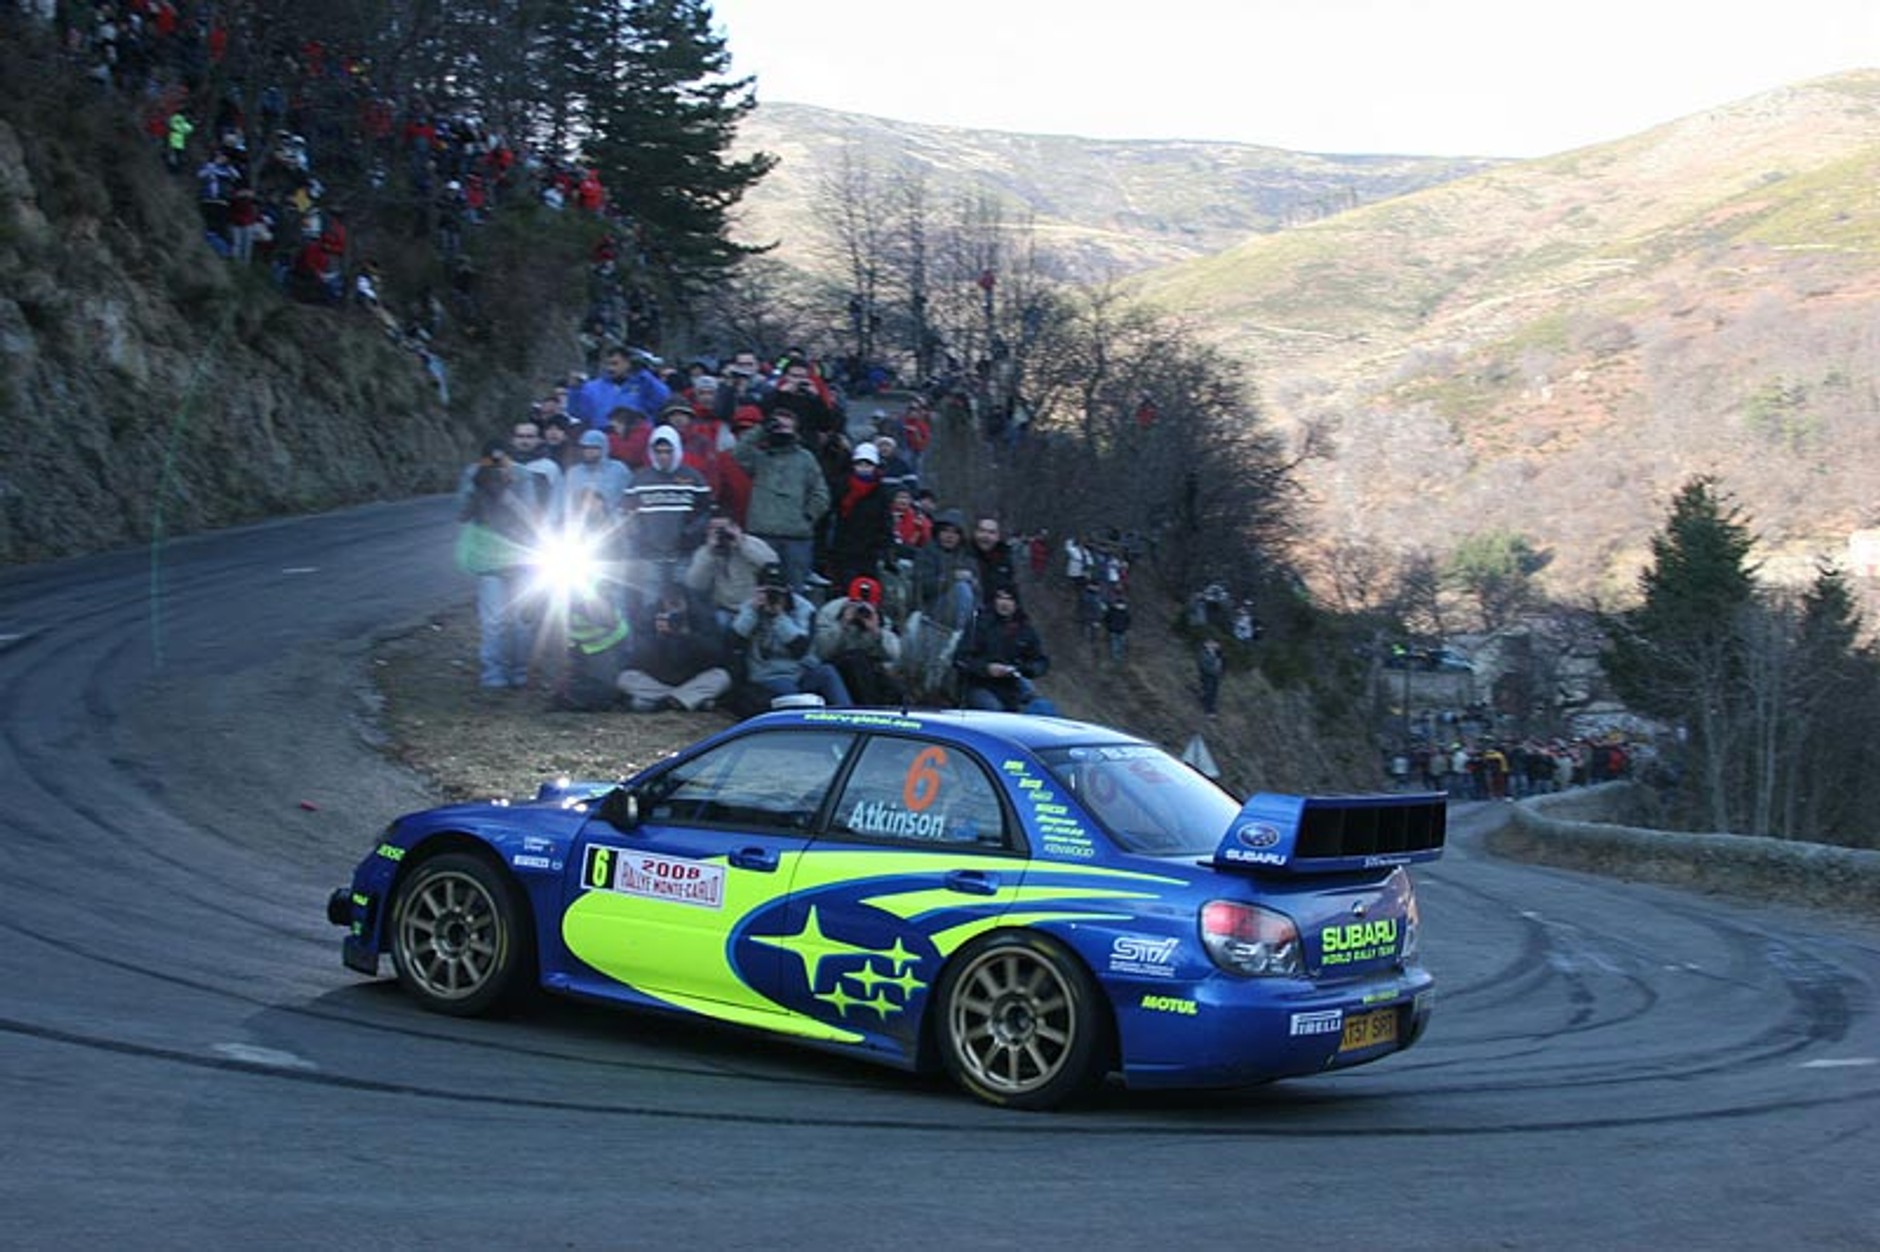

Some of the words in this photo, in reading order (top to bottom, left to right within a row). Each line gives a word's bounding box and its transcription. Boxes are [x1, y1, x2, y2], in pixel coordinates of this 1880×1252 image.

[903, 746, 948, 812] 6
[848, 801, 946, 838] Atkinson
[592, 848, 610, 888] 6
[641, 859, 701, 880] 2008
[1225, 850, 1287, 865] SUBARU
[1321, 918, 1397, 953] SUBARU
[1321, 951, 1352, 966] WORLD
[1353, 948, 1376, 961] RALLY
[1141, 995, 1198, 1015] MOTUL
[1290, 1008, 1343, 1036] PIRELLI
